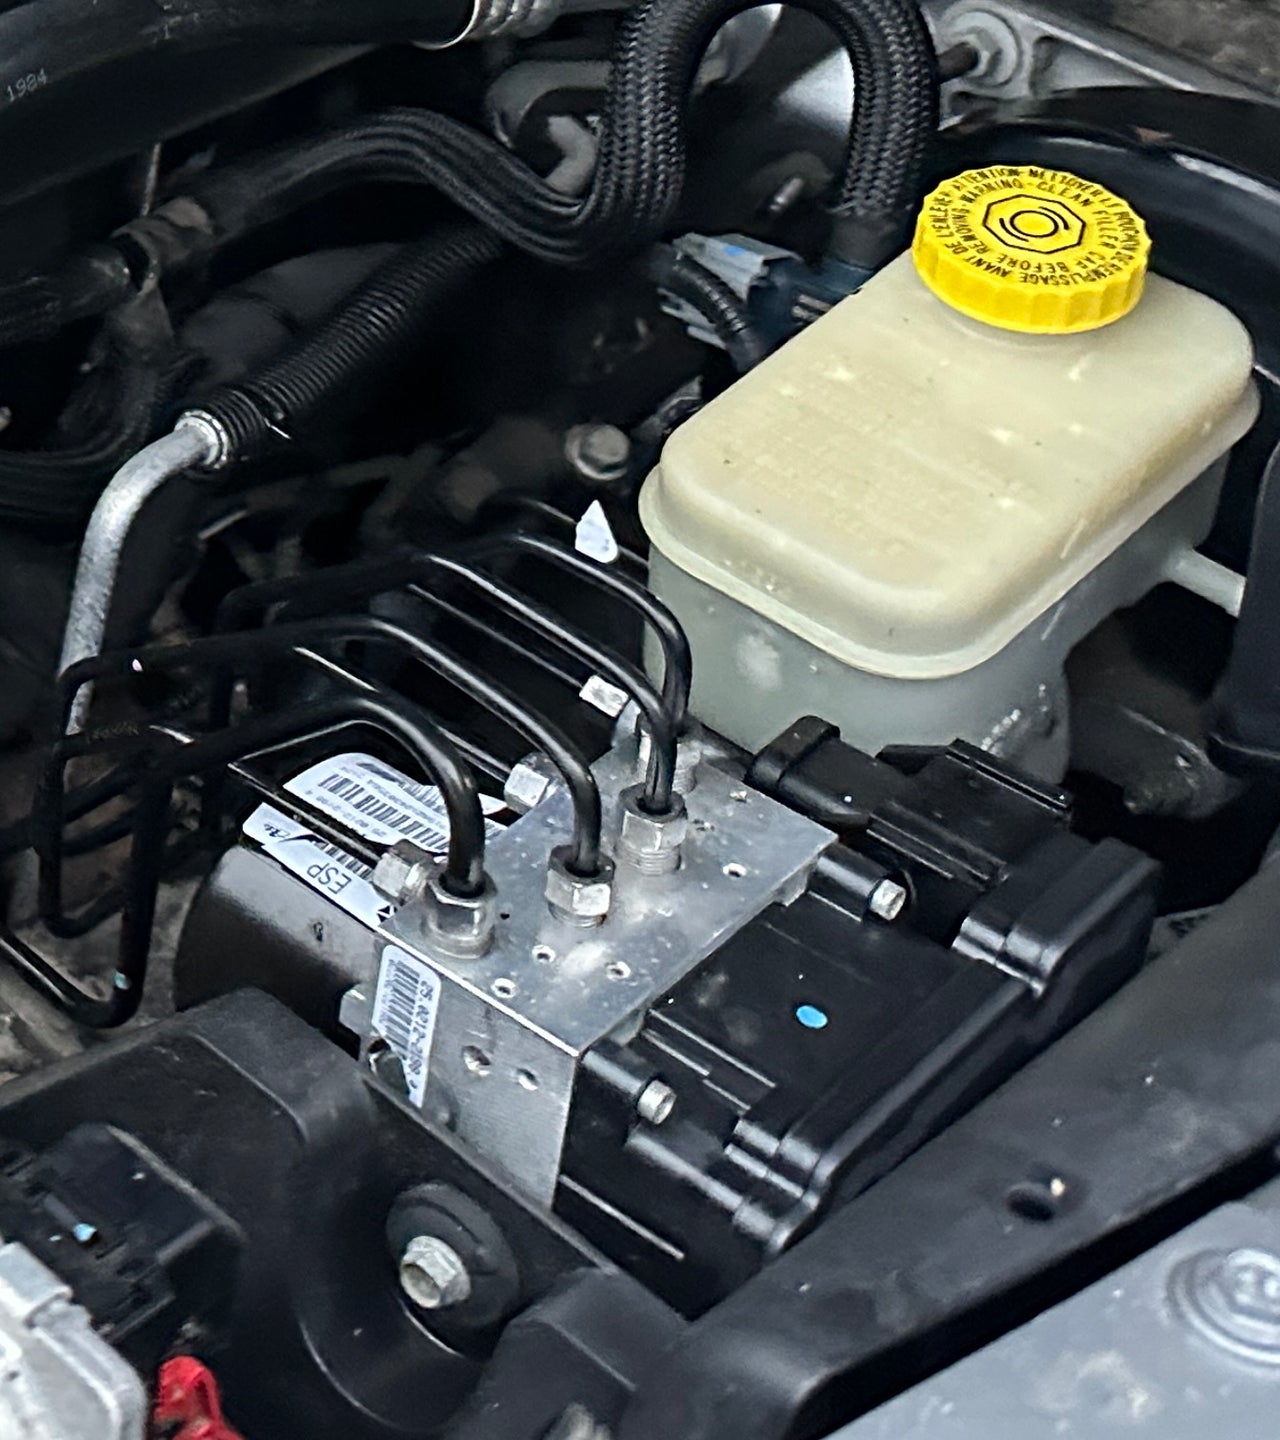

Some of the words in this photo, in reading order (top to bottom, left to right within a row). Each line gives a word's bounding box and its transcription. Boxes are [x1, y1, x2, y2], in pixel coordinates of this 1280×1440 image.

[1036, 181, 1095, 207] CLEAN
[1092, 210, 1119, 250] FILLER
[944, 241, 969, 255] DE
[964, 255, 1012, 277] AVANT
[996, 252, 1070, 273] BEFORE
[1076, 251, 1106, 269] CAP
[306, 862, 352, 895] ESP
